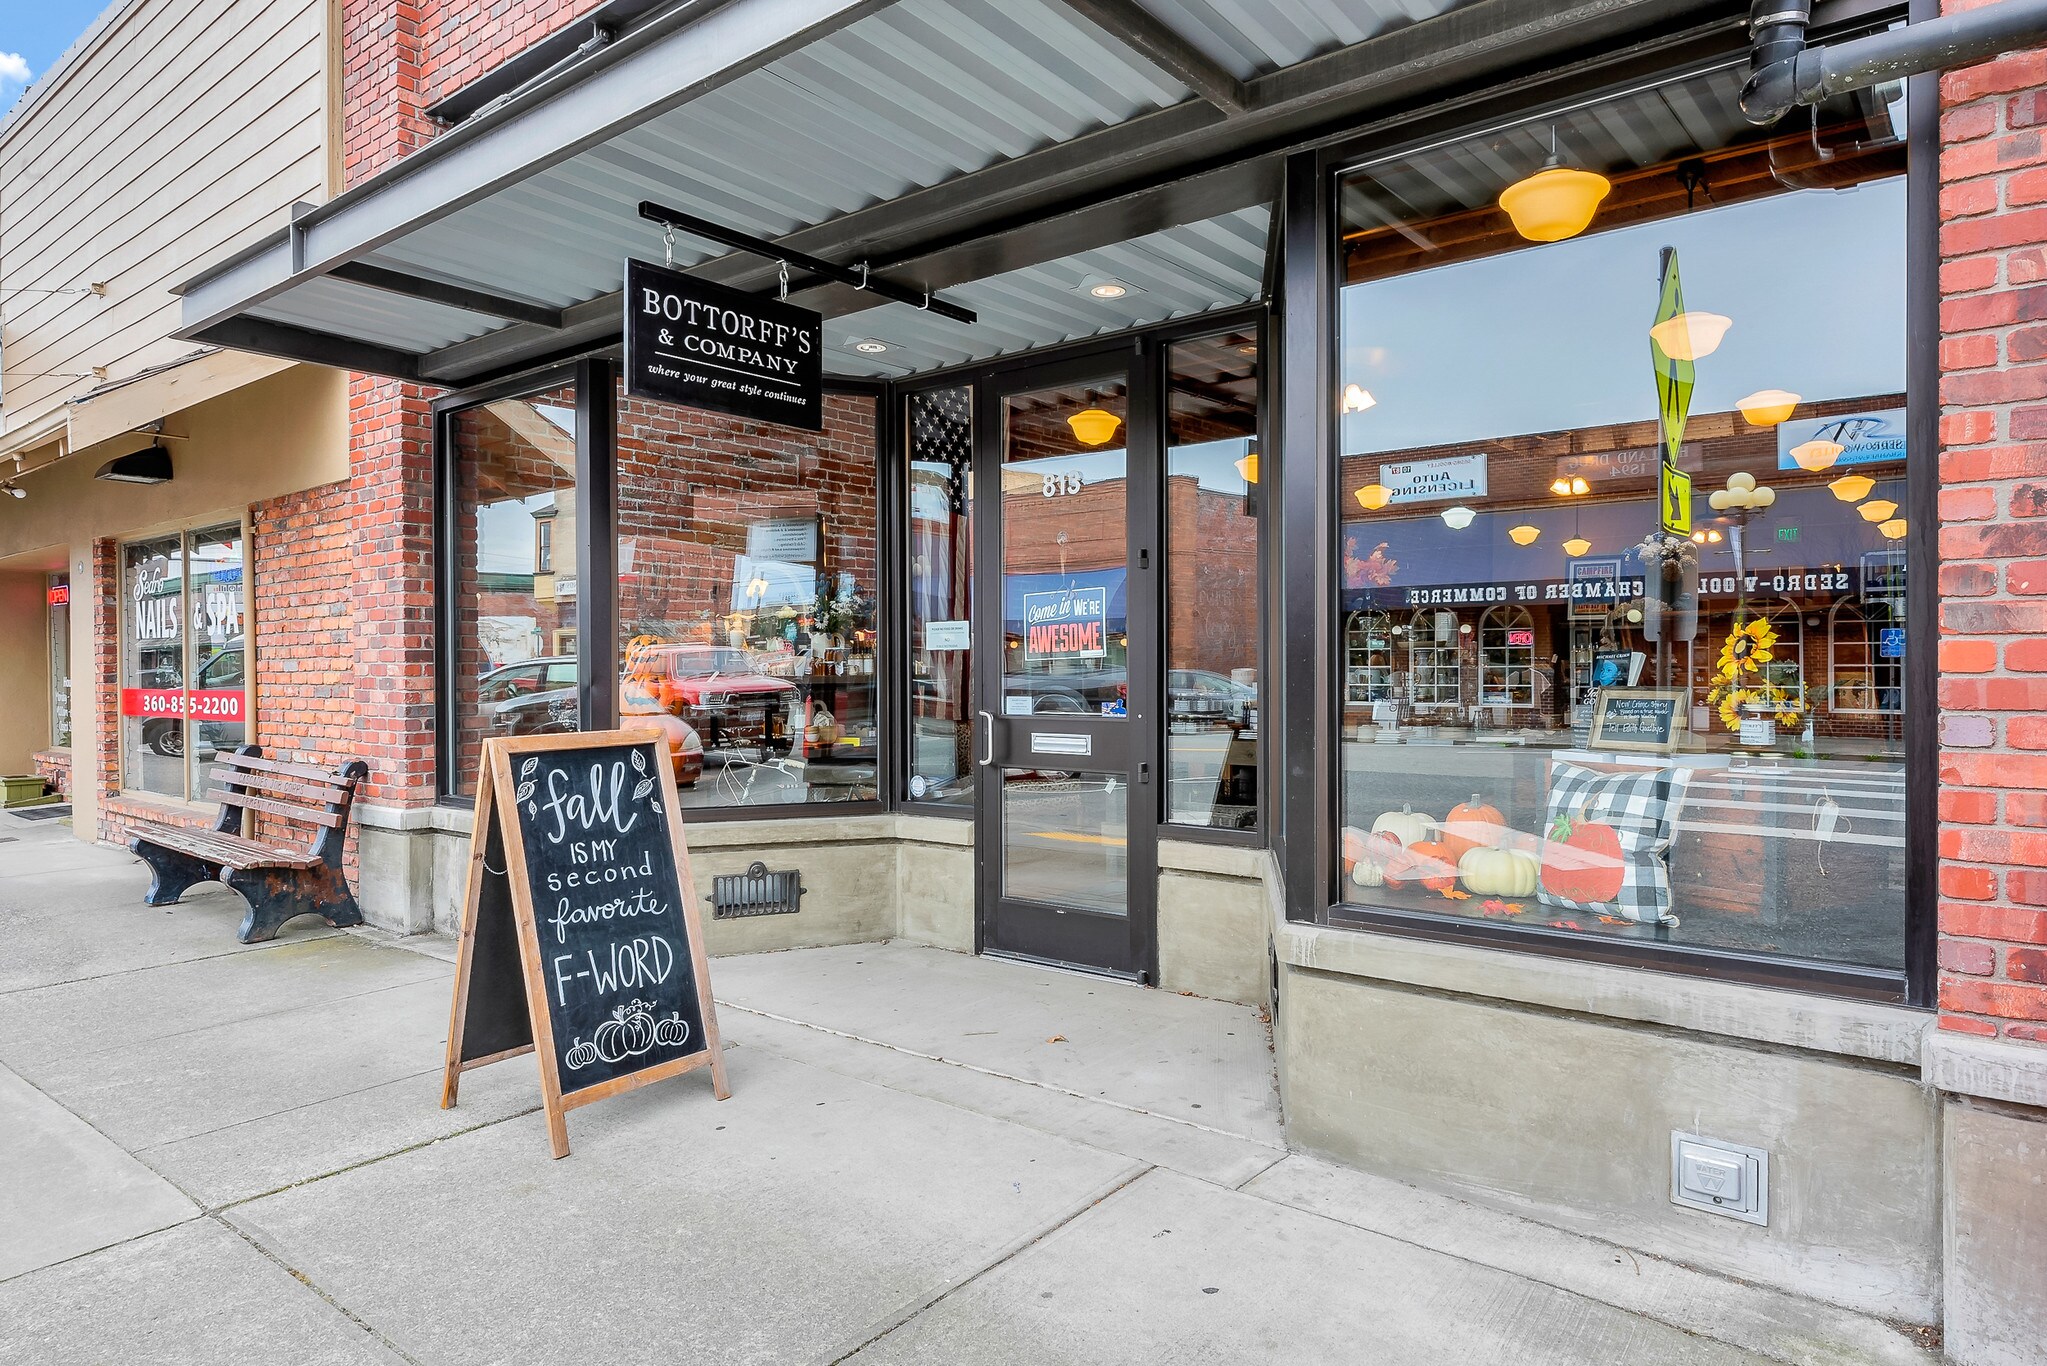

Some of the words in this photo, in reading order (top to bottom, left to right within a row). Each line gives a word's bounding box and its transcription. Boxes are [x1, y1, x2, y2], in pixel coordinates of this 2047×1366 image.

[642, 287, 811, 354] BOTTORFF'S
[658, 328, 674, 346] &
[684, 335, 799, 375] COMPANY
[648, 364, 680, 379] where
[683, 373, 708, 384] your
[711, 378, 737, 391] great
[739, 383, 762, 396] style
[764, 390, 807, 405] continues
[1043, 471, 1082, 498] 813
[1778, 527, 1798, 541] EXIT
[49, 588, 68, 603] OPEN
[1028, 603, 1058, 624] Come
[1059, 597, 1071, 615] in
[1073, 598, 1101, 616] WE'RE
[135, 597, 178, 640] NAILS
[193, 602, 203, 630] &
[206, 591, 240, 637] SPA
[1028, 622, 1102, 654] AWESOME
[143, 695, 239, 716] 360-855-2200
[542, 761, 638, 843] fall
[570, 842, 589, 865] IS
[592, 838, 617, 862] MY
[547, 850, 653, 891] second
[547, 888, 669, 944] favorite
[554, 935, 674, 1007] F-WORD
[1695, 1163, 1726, 1177] WATER
